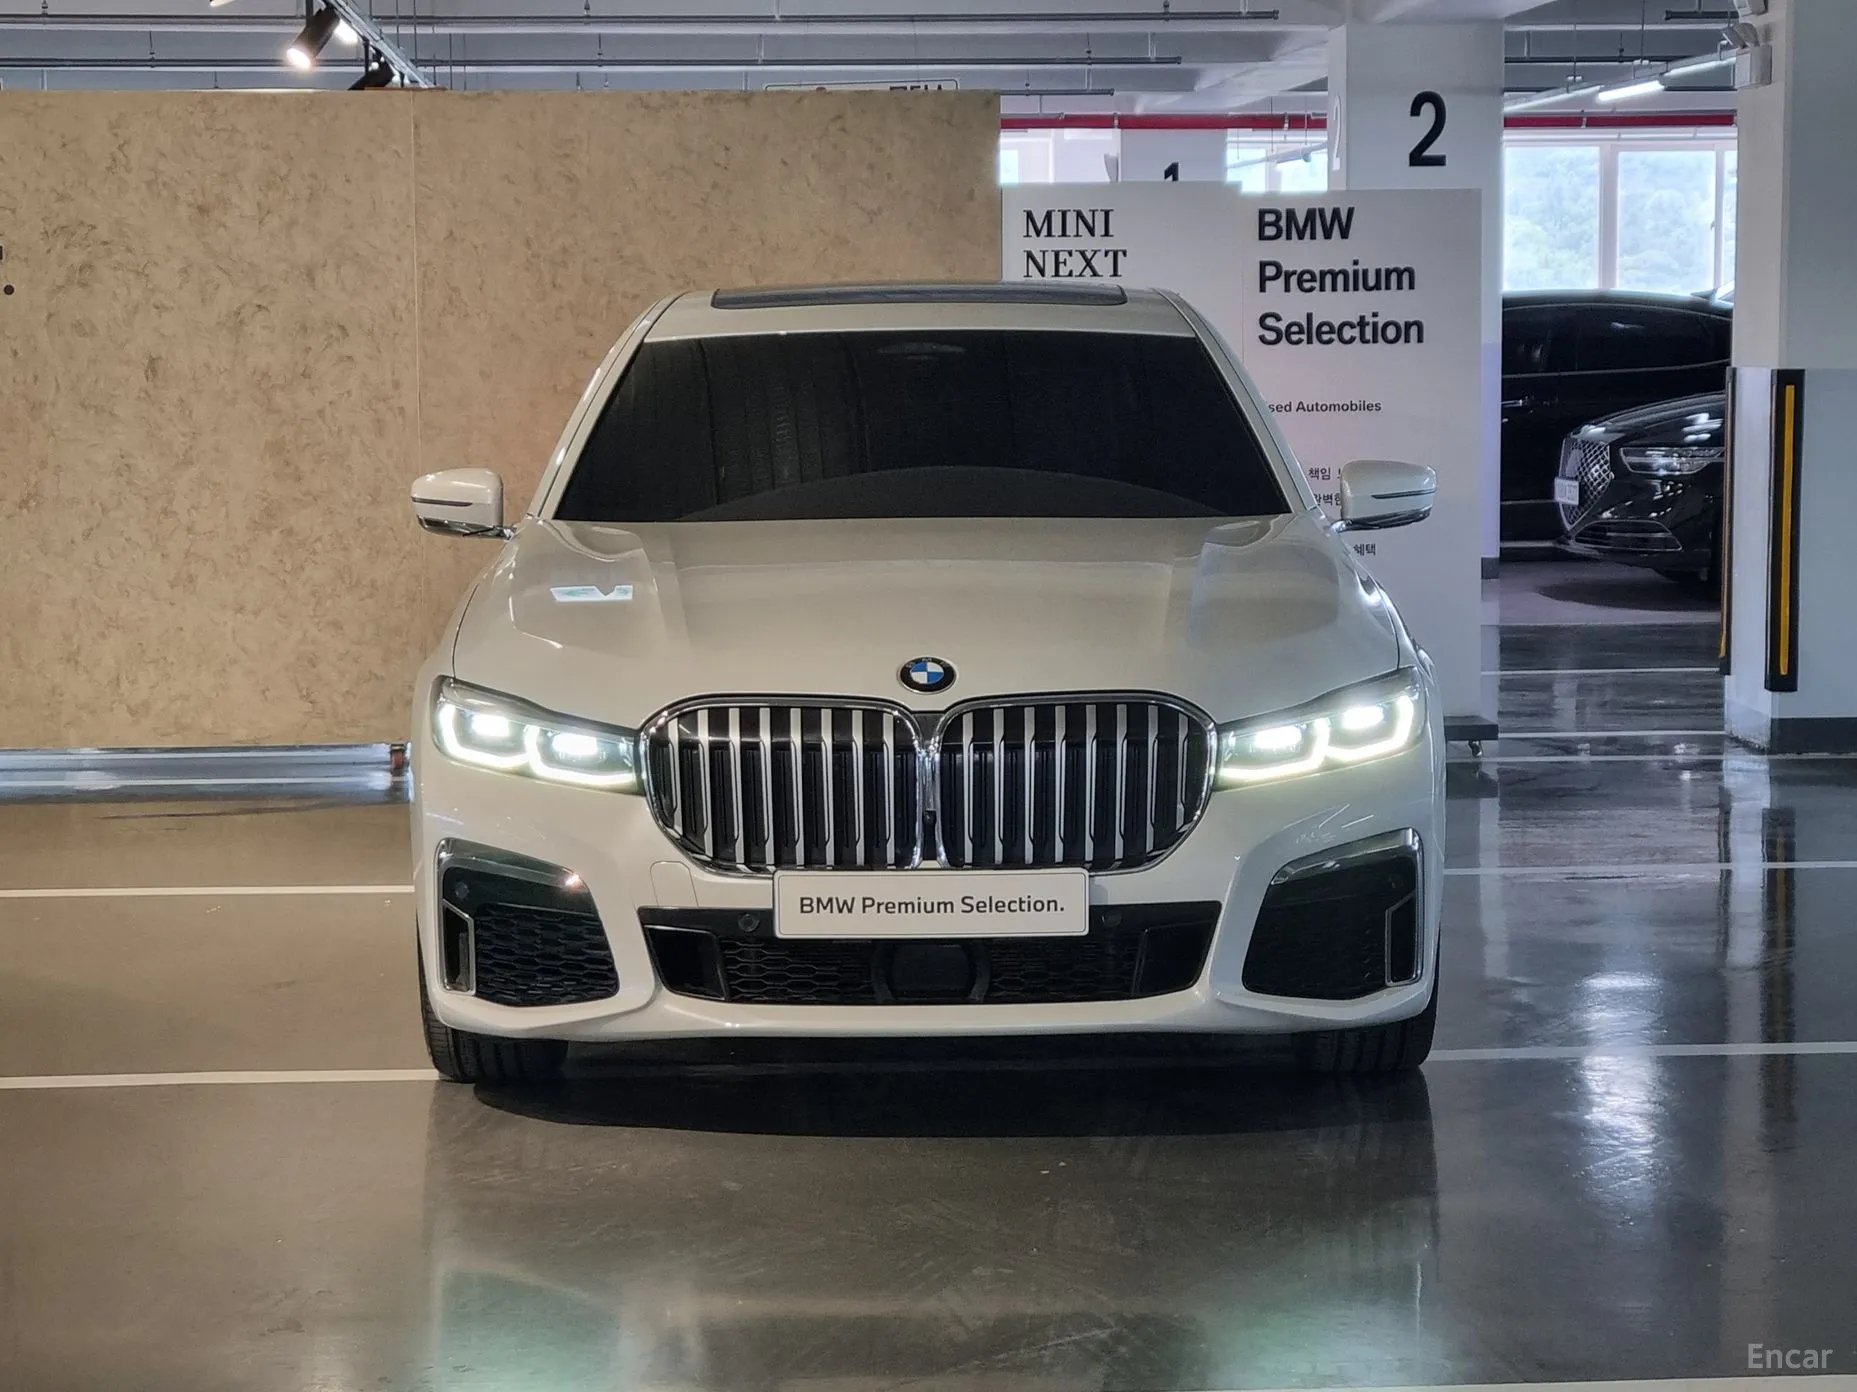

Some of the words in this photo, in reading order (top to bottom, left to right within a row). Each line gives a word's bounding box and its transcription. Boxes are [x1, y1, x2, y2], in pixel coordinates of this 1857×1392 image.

[1409, 90, 1447, 167] 2
[1023, 208, 1114, 239] MINI
[1258, 206, 1355, 242] BMW
[1023, 248, 1127, 279] NEXT
[1258, 258, 1416, 293] Premium
[1257, 311, 1425, 346] Selection
[1268, 401, 1292, 413] sed
[1296, 400, 1382, 413] Automobiles
[1308, 466, 1331, 481] 책임
[799, 896, 855, 914] BMW
[862, 896, 954, 914] Premium
[960, 894, 1065, 914] Selection.
